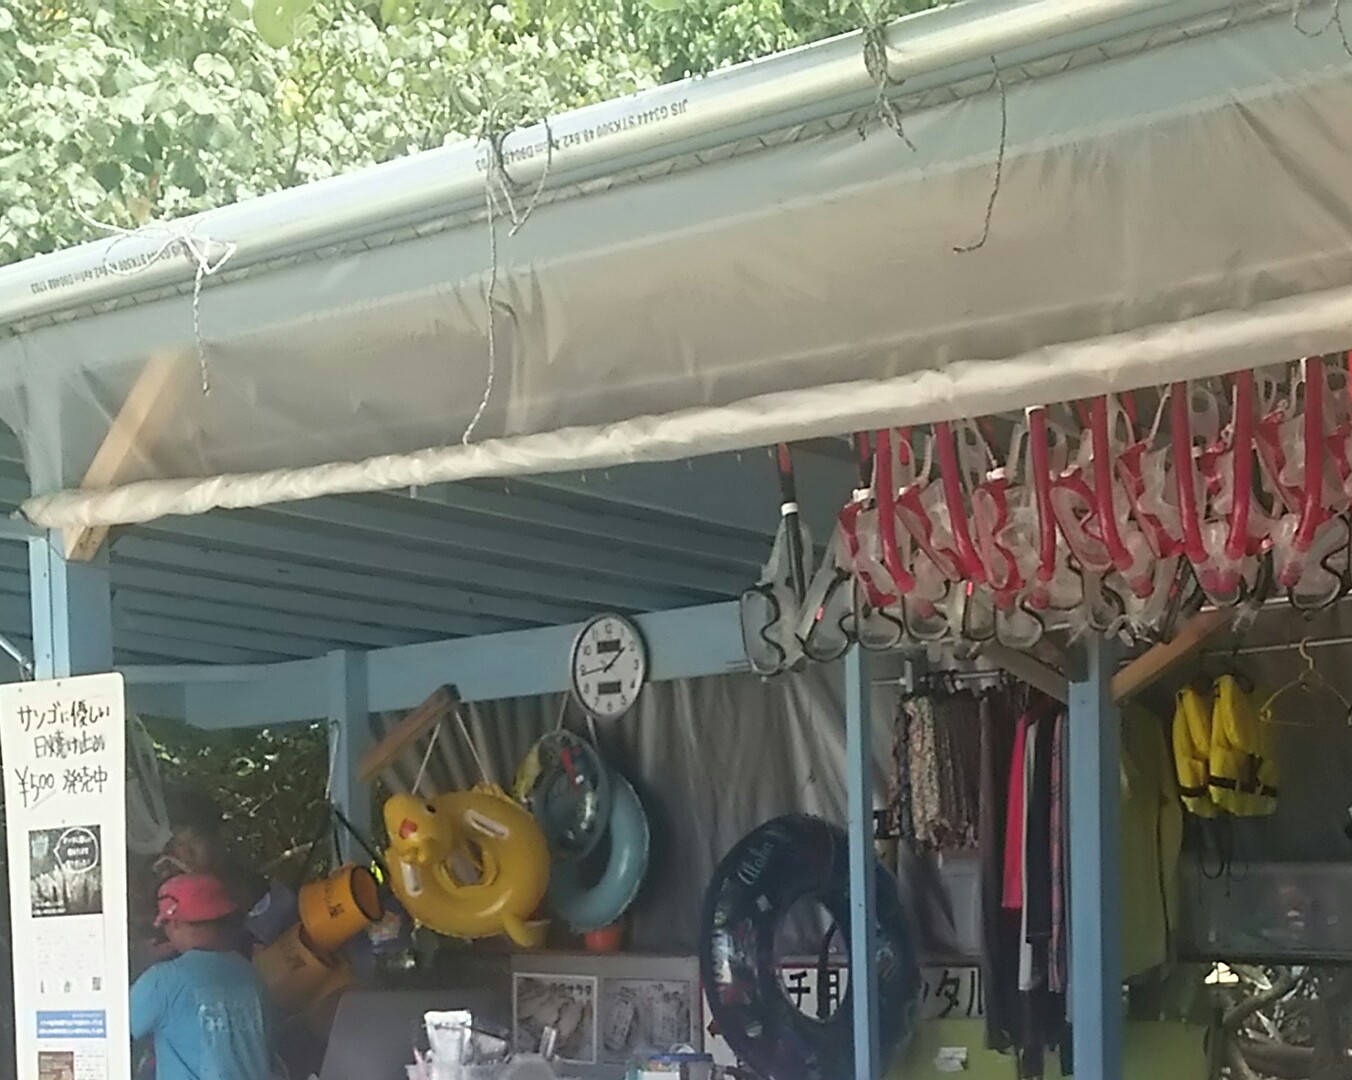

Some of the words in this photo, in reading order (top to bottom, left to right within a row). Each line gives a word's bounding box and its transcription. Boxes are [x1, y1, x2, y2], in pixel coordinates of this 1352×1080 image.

[669, 98, 689, 118] JIS
[17, 700, 111, 732] サンゴに優しい
[62, 764, 108, 795] 発売中
